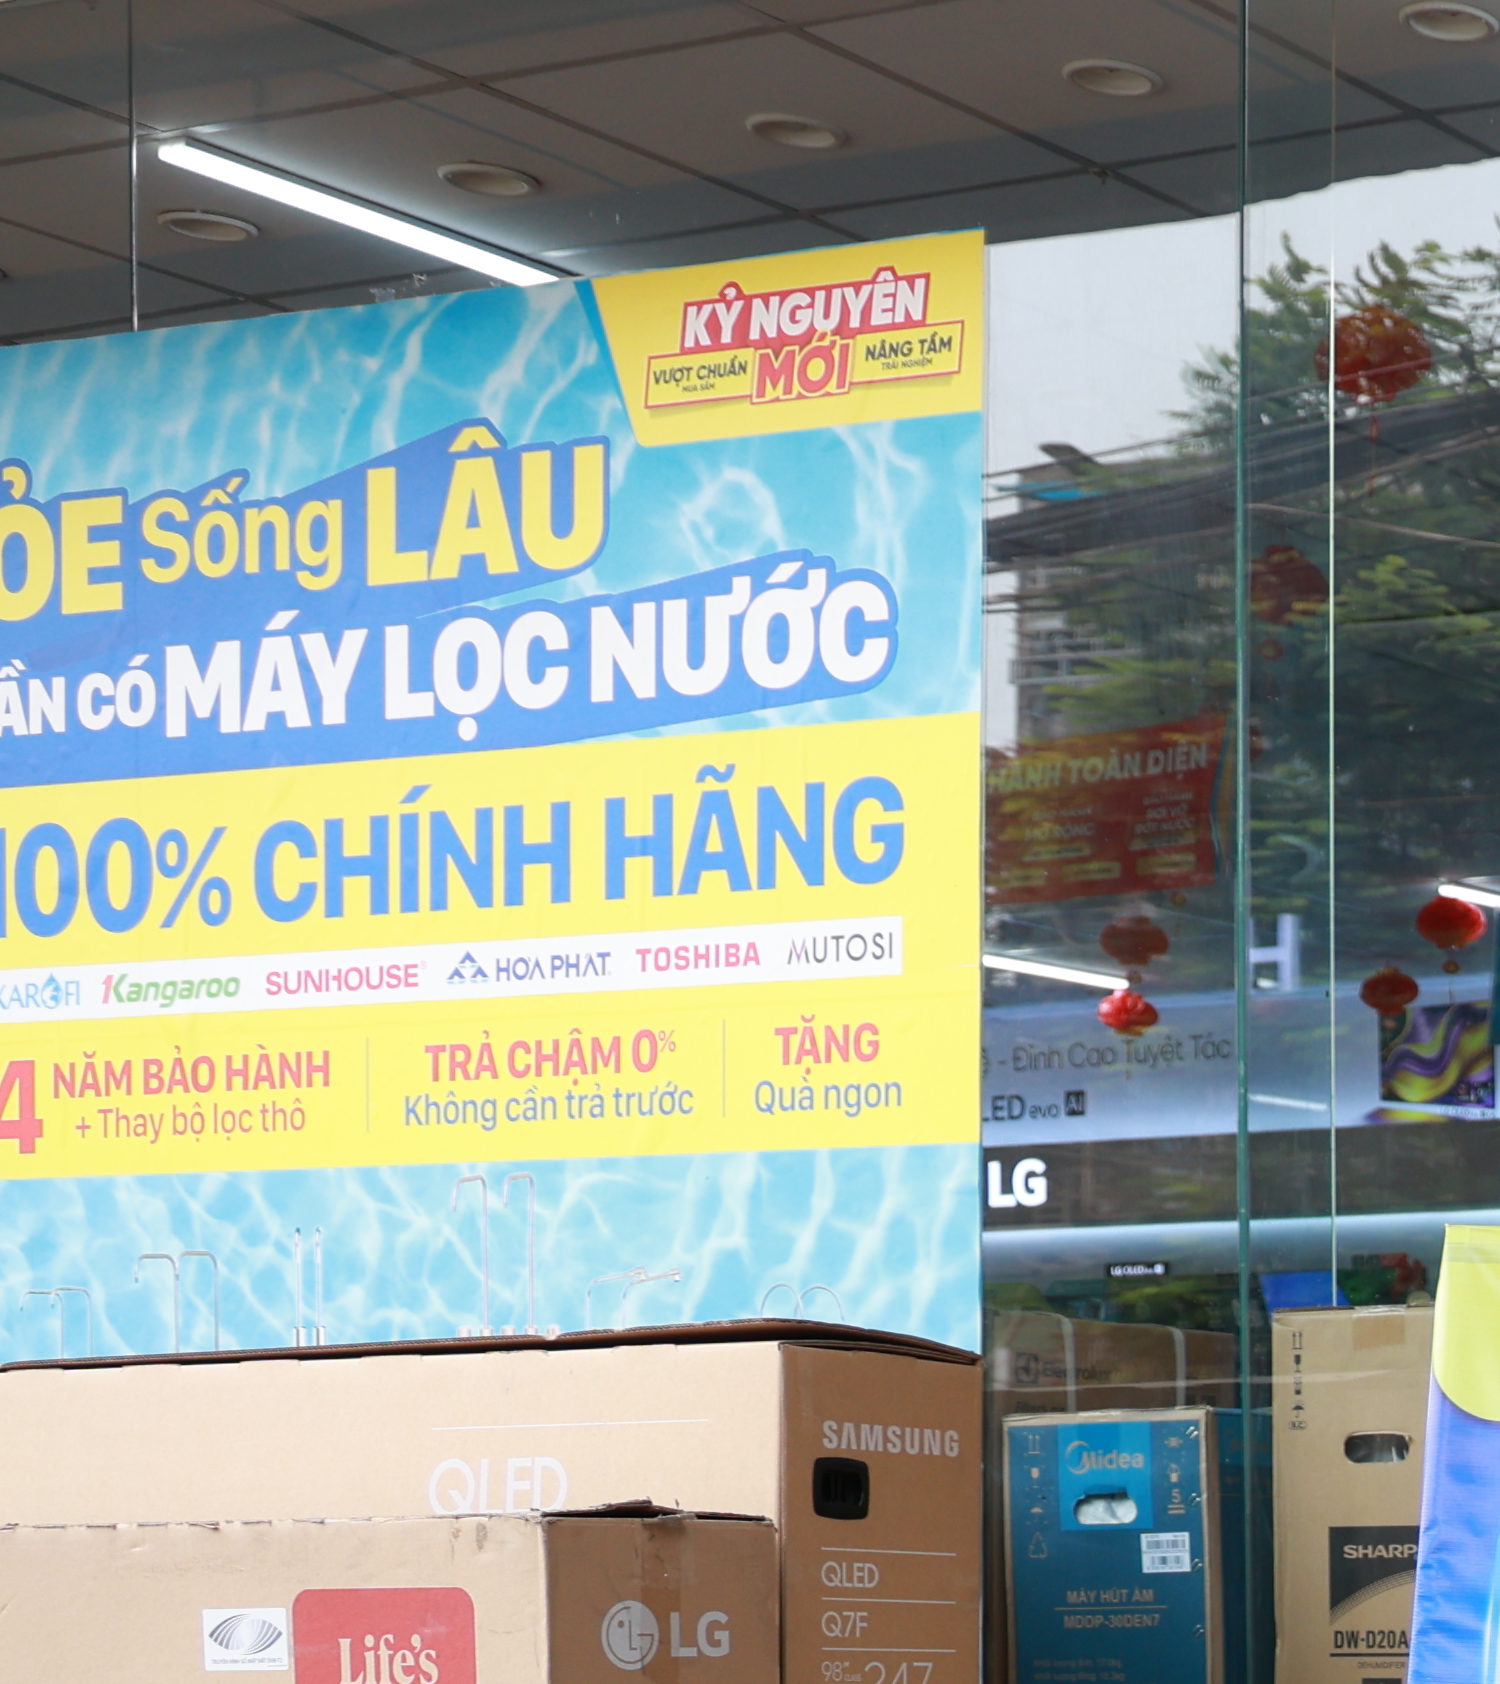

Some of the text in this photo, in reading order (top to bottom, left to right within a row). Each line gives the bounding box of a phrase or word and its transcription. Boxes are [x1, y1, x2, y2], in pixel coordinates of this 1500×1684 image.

[684, 270, 926, 347] KỶ NGUYÊN
[652, 359, 748, 387] VƯỢT CHUẨN
[755, 331, 851, 400] MỚI
[141, 428, 606, 591] Sống LÂU
[77, 561, 891, 741] CÓ MÁY LỌC NƯỚC
[254, 765, 905, 924] CHÍNH HÃNG
[265, 931, 894, 996] SUNHOUSE TOSHIBA MUTOSI
[425, 1028, 621, 1086] TRẢ CHẬM
[775, 1014, 880, 1075] TẶNG
[52, 1044, 331, 1099] NĂM BẢO HÀNH
[754, 1075, 903, 1118] Quà ngon
[98, 1098, 305, 1144] Thay bộ lọc thô
[403, 1081, 694, 1132] Không cần trả trước
[987, 1157, 1048, 1208] LG
[822, 1420, 960, 1457] SAMSUNG
[1065, 1440, 1145, 1475] Midea
[427, 1455, 569, 1515] QLED
[821, 1560, 879, 1589] QLED
[1343, 1544, 1417, 1559] SHARP
[670, 1611, 732, 1659] LG
[821, 1611, 869, 1638] Q7F
[1334, 1630, 1409, 1649] DW-D20A
[338, 1634, 439, 1684] Life's
